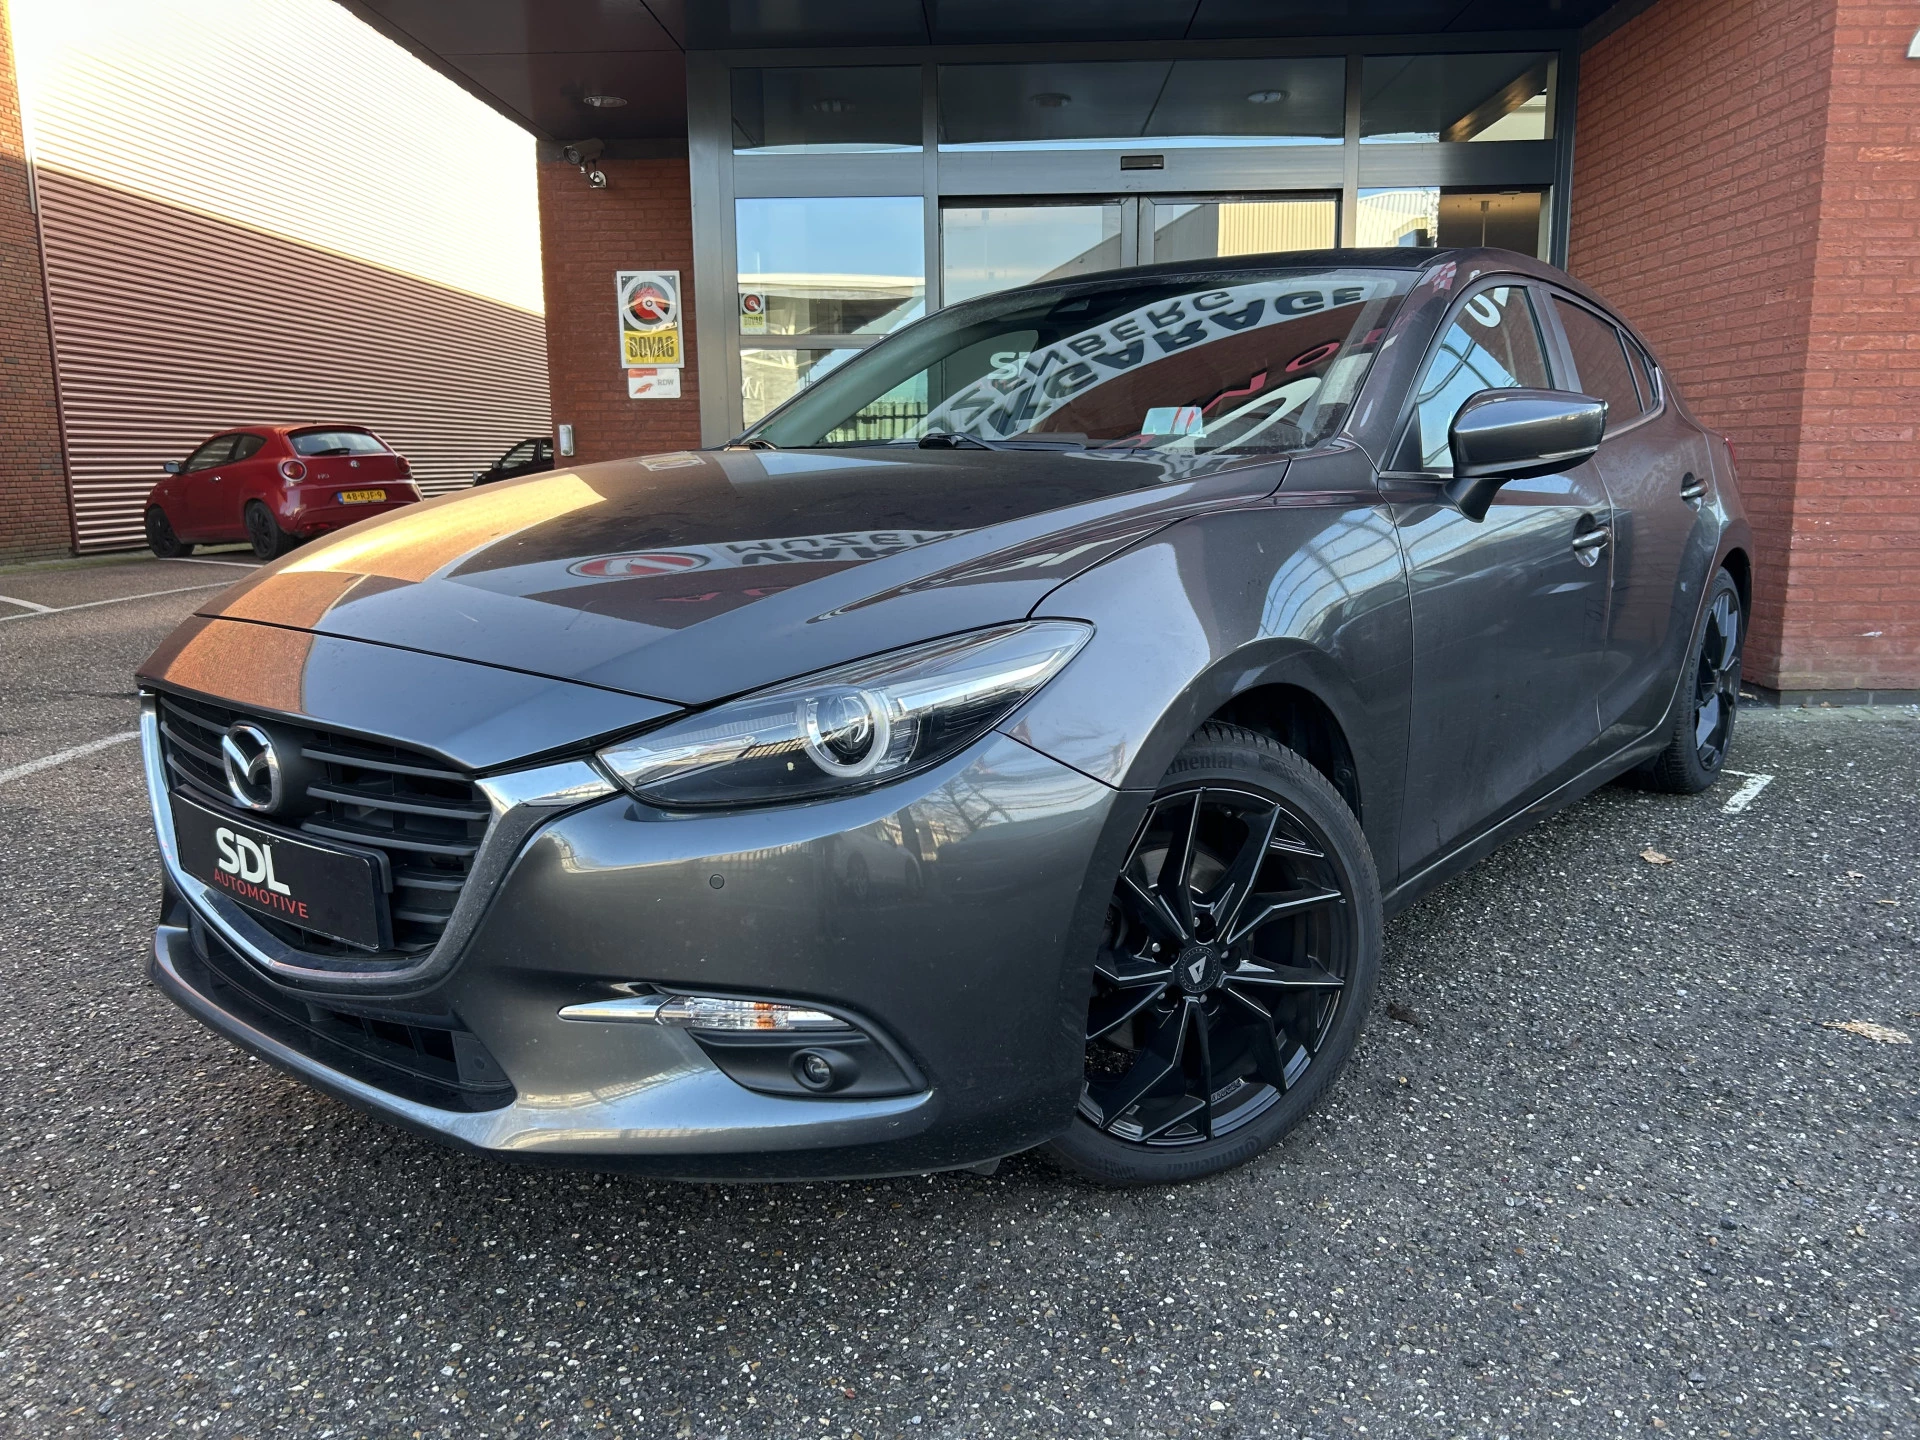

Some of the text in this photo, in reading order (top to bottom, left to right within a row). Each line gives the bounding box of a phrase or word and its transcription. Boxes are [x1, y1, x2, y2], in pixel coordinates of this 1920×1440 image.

[629, 336, 675, 358] BOVAG
[657, 379, 674, 387] RDW
[216, 827, 291, 896] SDL
[214, 868, 309, 919] AUTOMOTIVE
